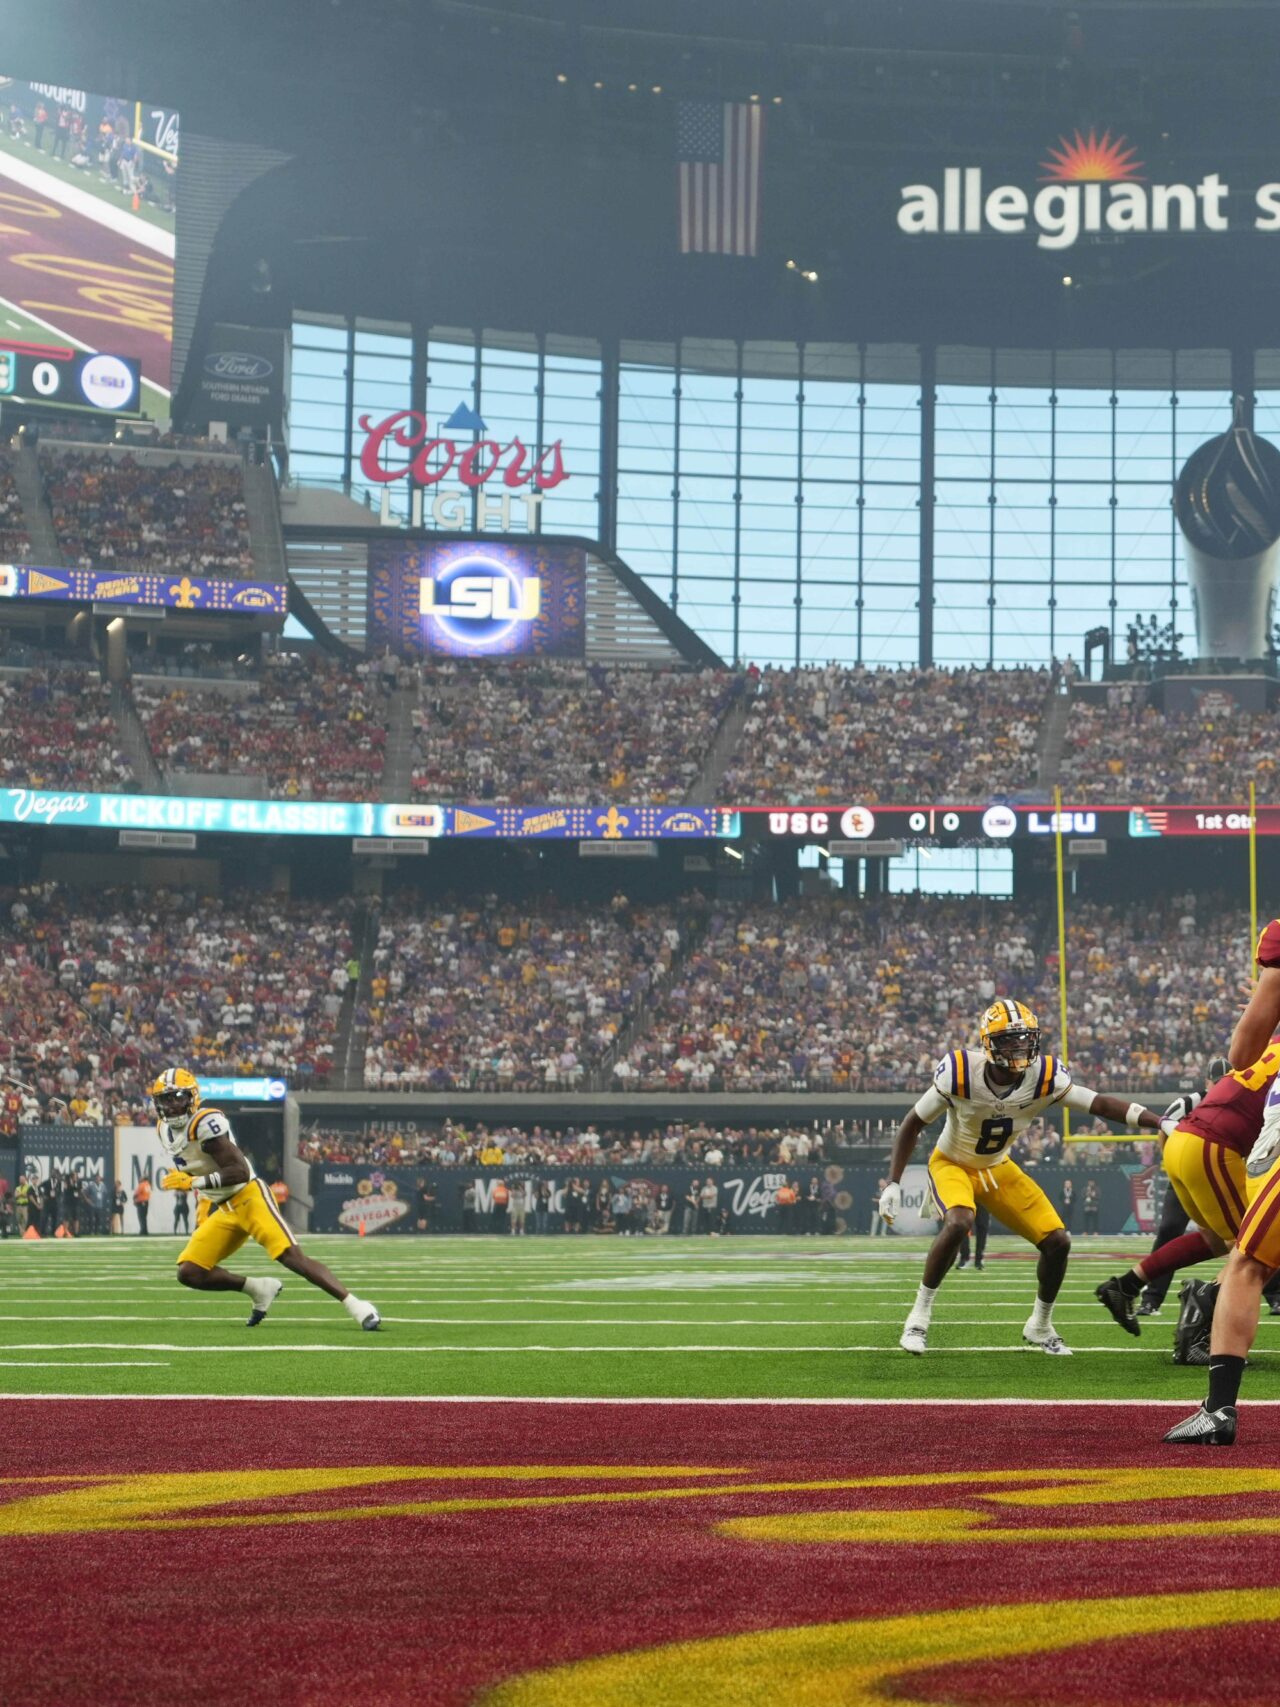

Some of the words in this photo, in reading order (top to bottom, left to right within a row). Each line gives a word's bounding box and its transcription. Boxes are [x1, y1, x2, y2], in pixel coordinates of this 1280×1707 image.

[897, 167, 1229, 249] allegiant
[214, 356, 259, 376] Ford
[32, 362, 59, 395] 0
[358, 410, 570, 489] Coors
[380, 488, 545, 534] LIGHT
[419, 576, 541, 621] LSU
[8, 788, 88, 824] Vegas
[100, 796, 224, 827] KICKOFF
[230, 802, 346, 832] CLASSIC
[1195, 813, 1222, 830] 1st
[768, 812, 830, 835] USC
[909, 812, 926, 832] 0
[943, 812, 960, 832] 0
[1027, 812, 1096, 833] LSU
[207, 1118, 221, 1135] 6
[974, 1117, 1014, 1155] 8
[53, 1155, 105, 1179] MGM
[324, 1172, 354, 1185] Modelo
[362, 1207, 400, 1221] VEGAS
